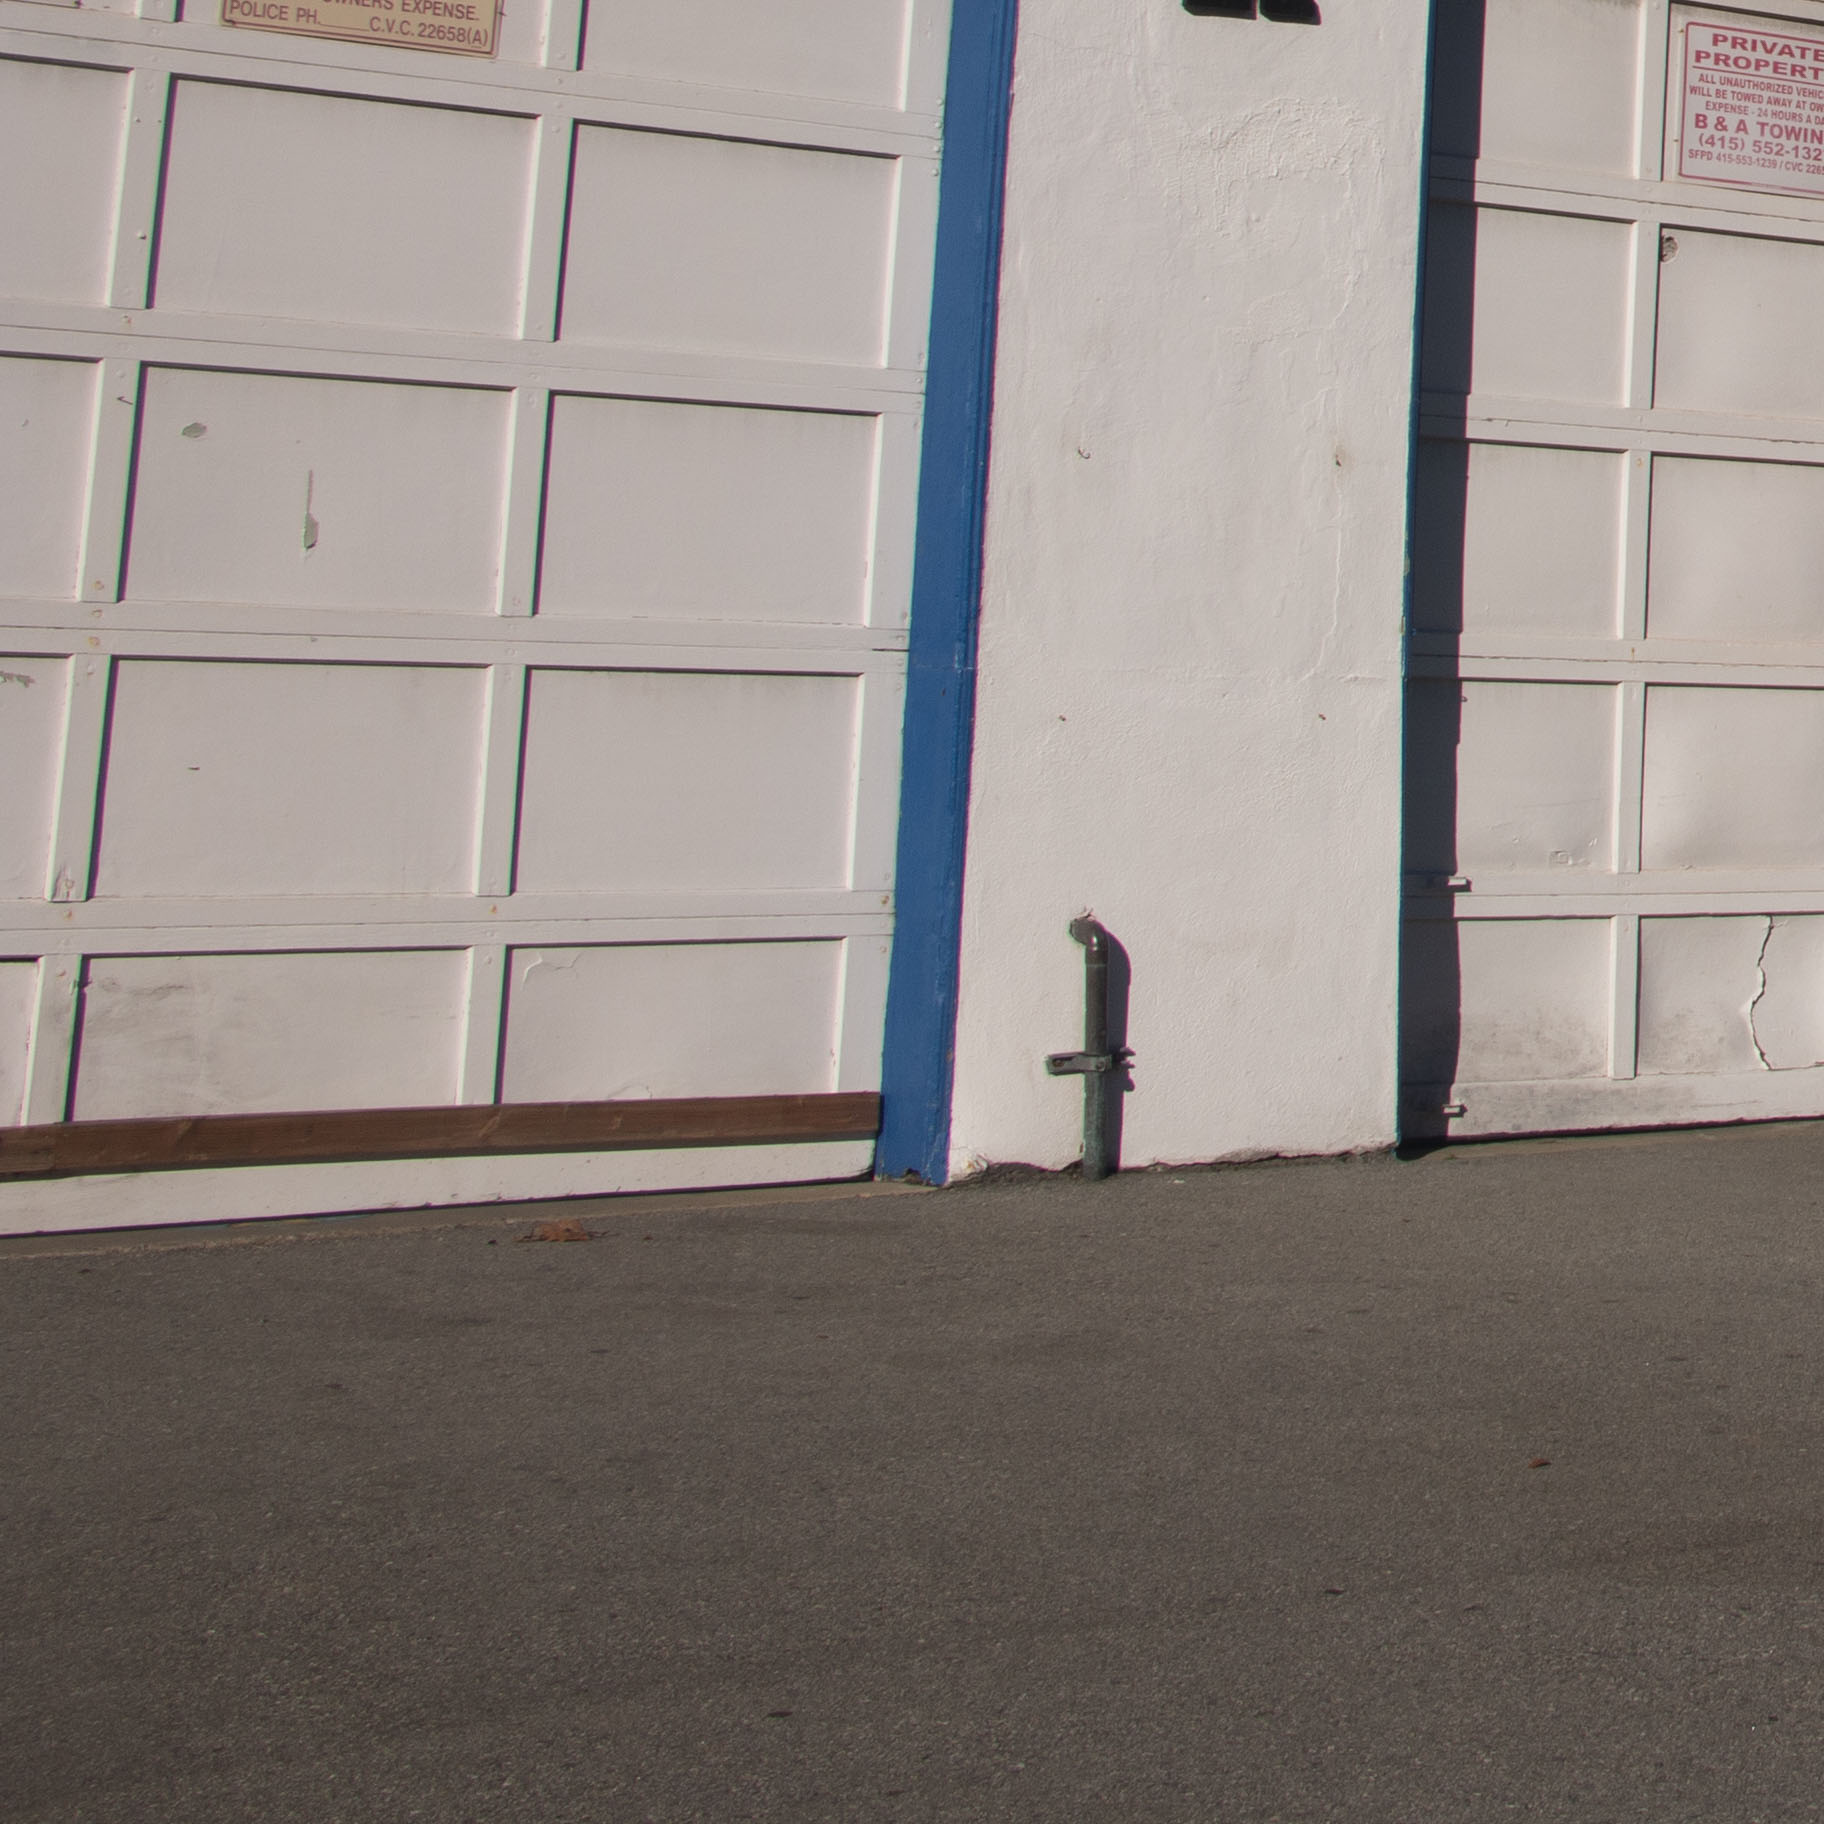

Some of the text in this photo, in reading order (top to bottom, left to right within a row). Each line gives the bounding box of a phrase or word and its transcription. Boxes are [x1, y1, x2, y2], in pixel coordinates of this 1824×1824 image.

[369, 16, 415, 38] C.V.C.
[417, 25, 489, 48] 22658(A)
[1698, 72, 1717, 85] ALL
[1719, 75, 1794, 96] UNAUTHORIZED
[1689, 84, 1713, 98] WILL
[1715, 88, 1728, 100] BE
[1730, 90, 1764, 105] TOWED
[1766, 95, 1793, 109] AWAY
[1796, 99, 1807, 111] AT
[1694, 112, 1709, 129] B
[1713, 115, 1729, 133] &
[1735, 118, 1750, 135] A
[1705, 100, 1750, 116] EXPENSE
[1757, 107, 1769, 118] 24
[1771, 110, 1804, 123] HOURS
[1805, 114, 1814, 125] A
[1698, 132, 1746, 152] (415)
[1688, 148, 1713, 161] SFPD
[1784, 160, 1804, 173] CVC
